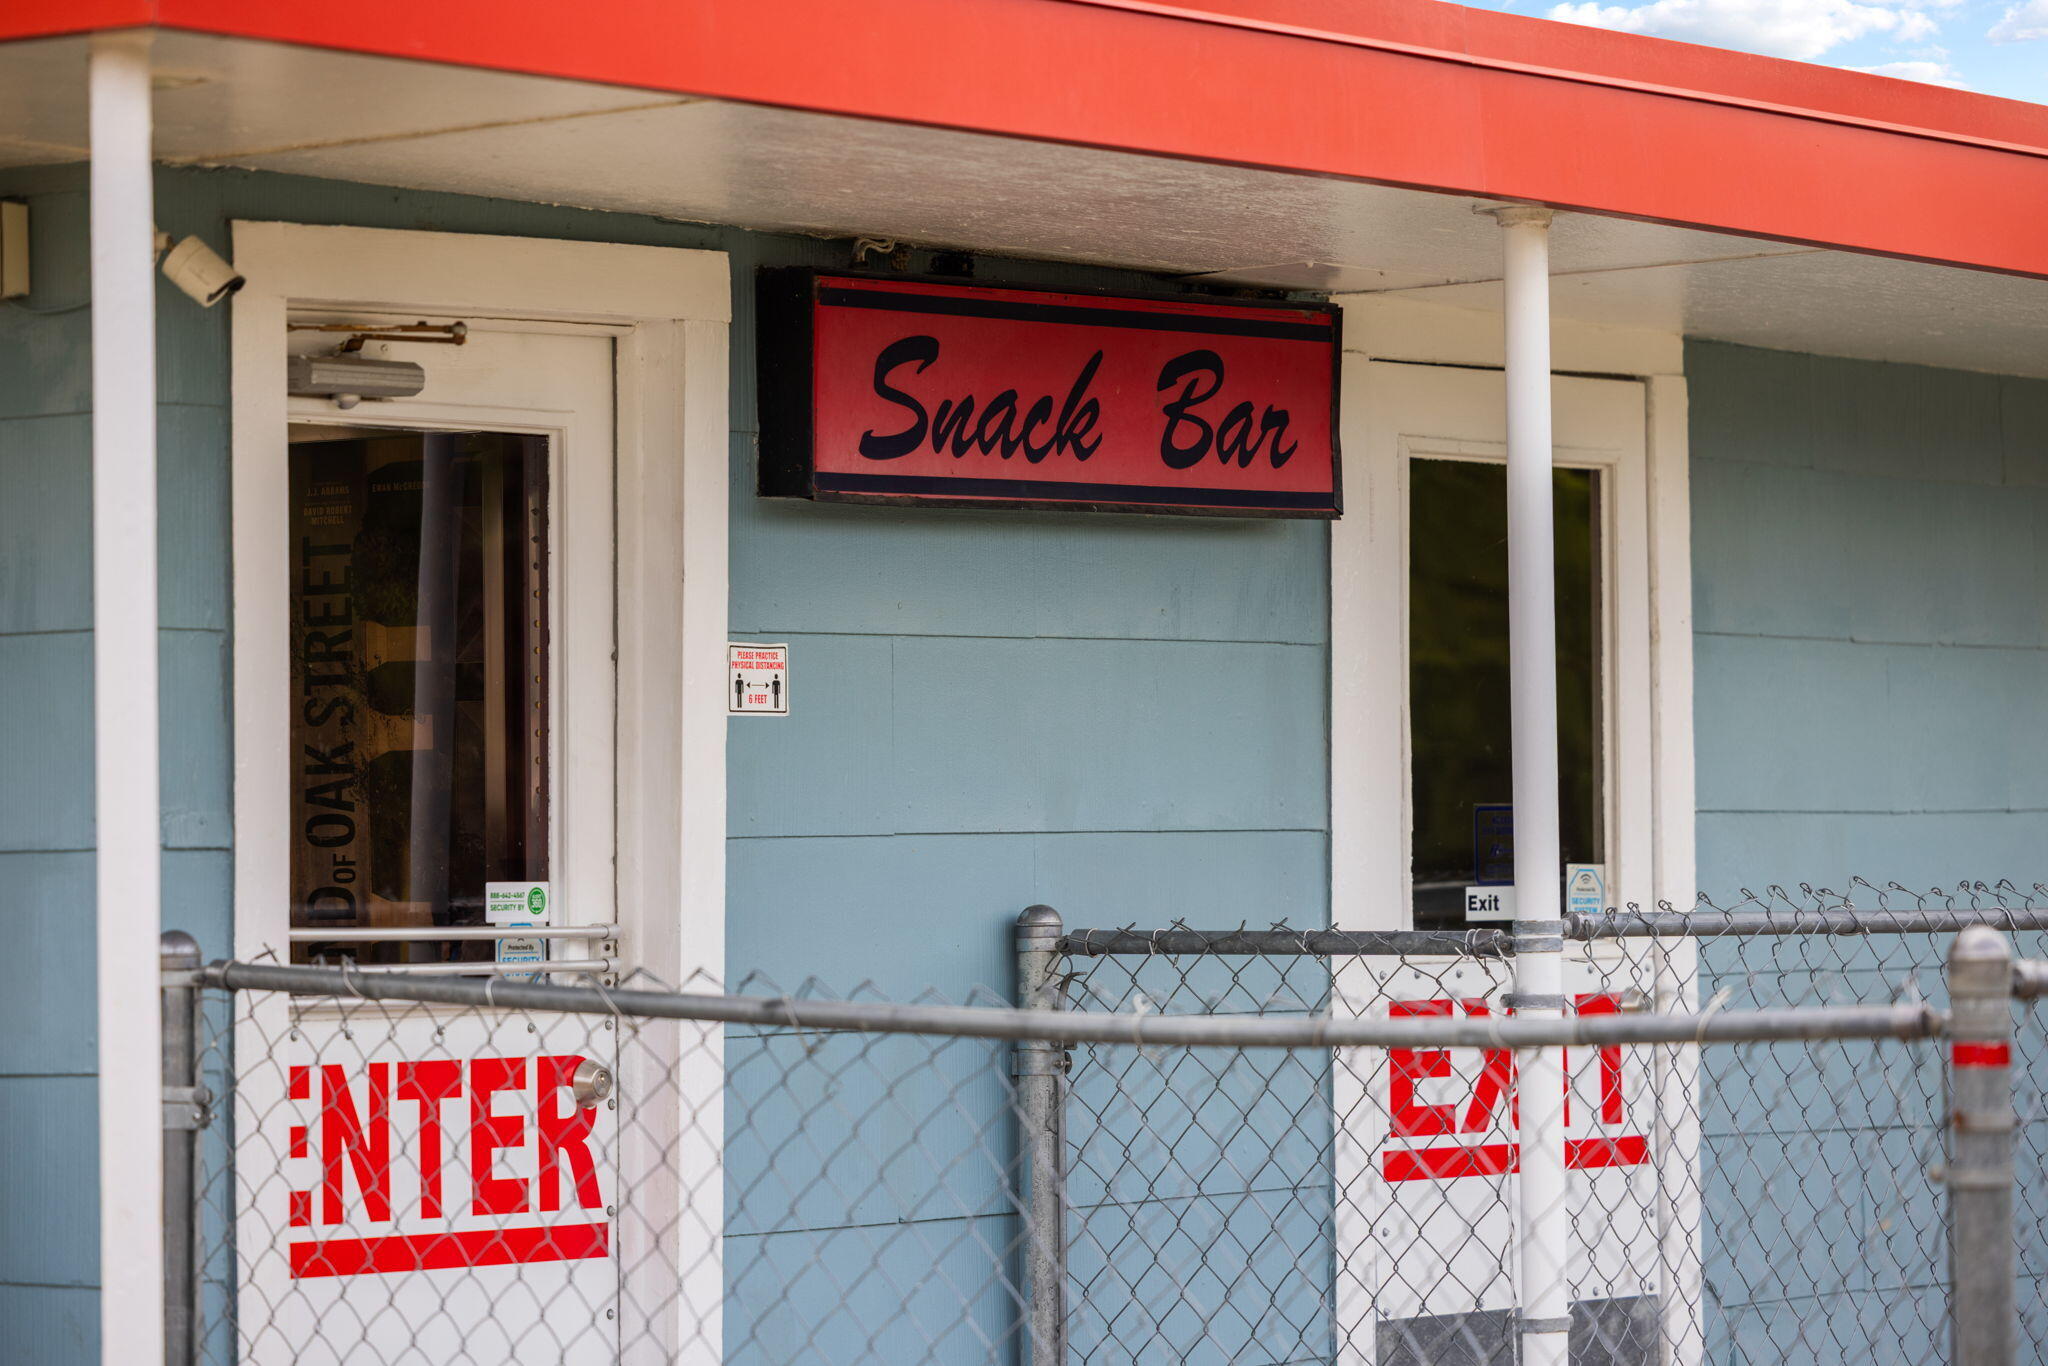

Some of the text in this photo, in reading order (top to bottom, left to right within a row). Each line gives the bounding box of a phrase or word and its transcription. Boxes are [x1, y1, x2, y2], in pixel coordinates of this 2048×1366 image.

[858, 335, 1298, 469] Snack Bar
[302, 536, 354, 727] STREET
[732, 661, 784, 670] PHYSICAL DISTANCING
[737, 651, 778, 660] PLEASE PRACTICE
[749, 694, 768, 704] 6 FEET
[304, 741, 356, 848] OAK
[333, 853, 356, 884] OF
[1468, 894, 1499, 912] Exit
[1389, 991, 1622, 1138] EXT
